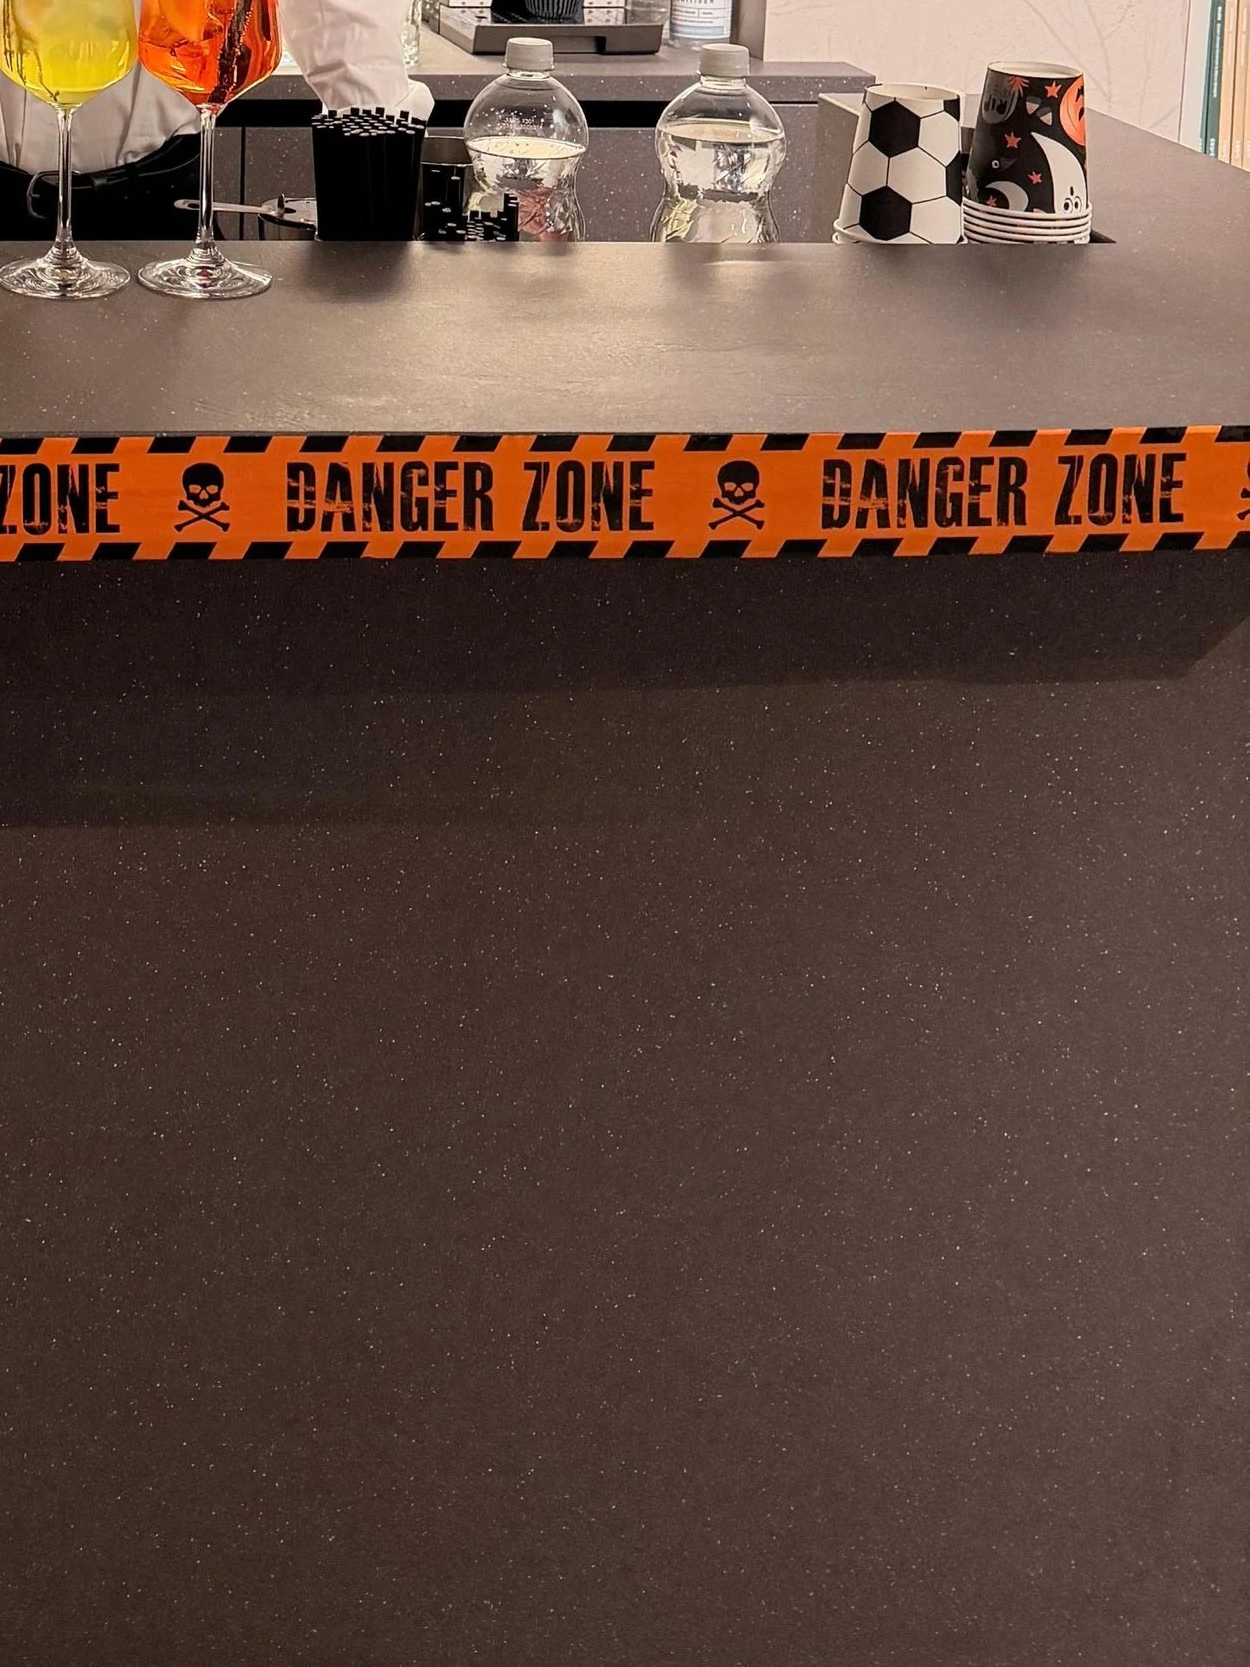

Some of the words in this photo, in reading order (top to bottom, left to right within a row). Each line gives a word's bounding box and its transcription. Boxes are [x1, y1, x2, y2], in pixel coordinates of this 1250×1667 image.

[286, 461, 495, 533] DANGER
[522, 460, 656, 532] ZONE
[821, 456, 1029, 530] DANGER
[1054, 452, 1188, 526] ZONE
